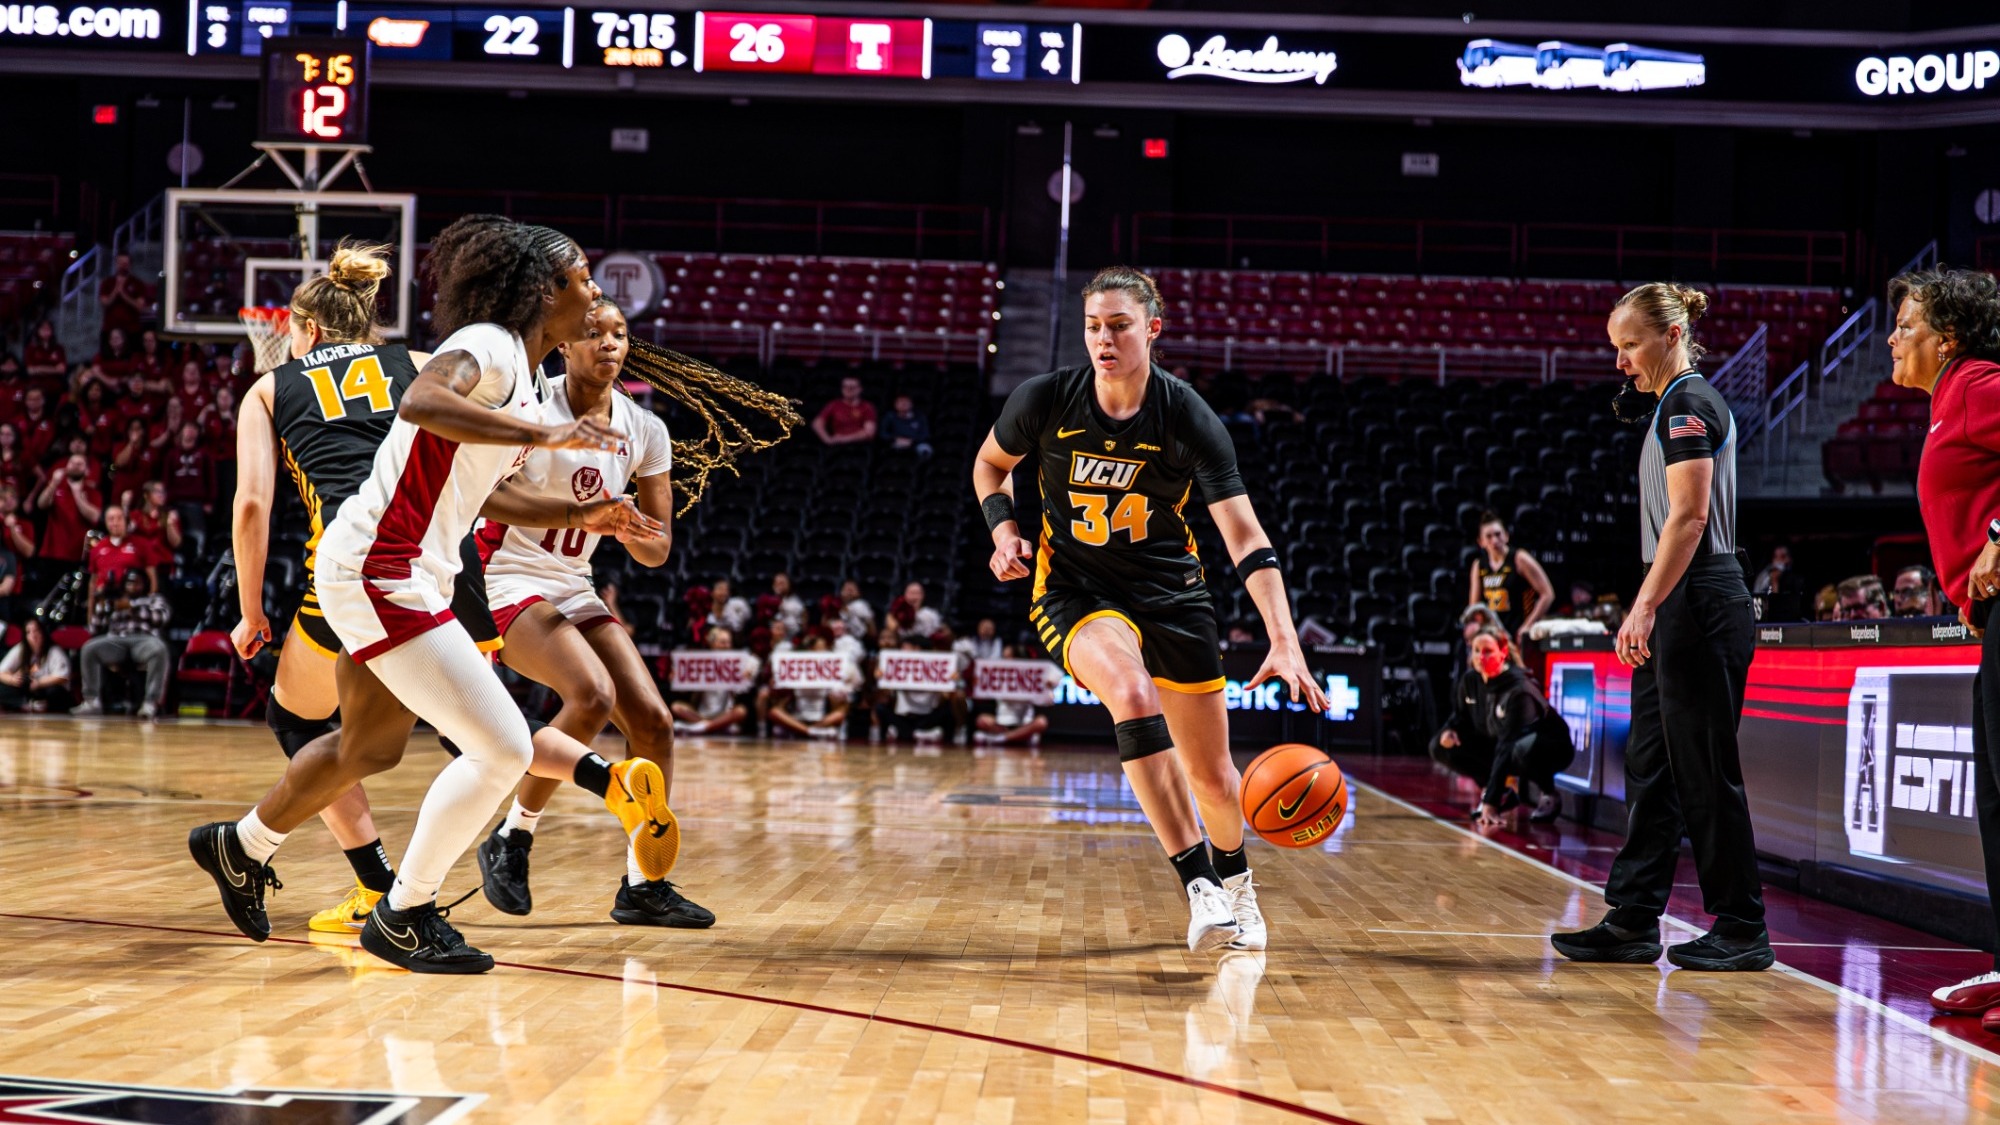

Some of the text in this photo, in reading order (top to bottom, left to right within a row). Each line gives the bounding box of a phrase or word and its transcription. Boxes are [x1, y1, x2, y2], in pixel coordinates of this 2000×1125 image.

[207, 23, 227, 47] 3
[484, 15, 540, 55] 22
[592, 12, 675, 50] 7:15
[729, 22, 785, 63] 26
[295, 53, 354, 86] 7:15
[991, 47, 1011, 73] 2
[1041, 49, 1061, 75] 4
[1855, 50, 2000, 96] GROUP
[302, 85, 346, 138] 12
[300, 354, 395, 422] 14
[1072, 456, 1138, 489] VCU
[1067, 490, 1154, 547] 34
[1931, 622, 1961, 641] Independence
[677, 658, 742, 683] DEFENSE
[778, 658, 842, 682] DEFENSE
[884, 658, 950, 683] DEFENSE
[978, 665, 1044, 693] DEFENSE
